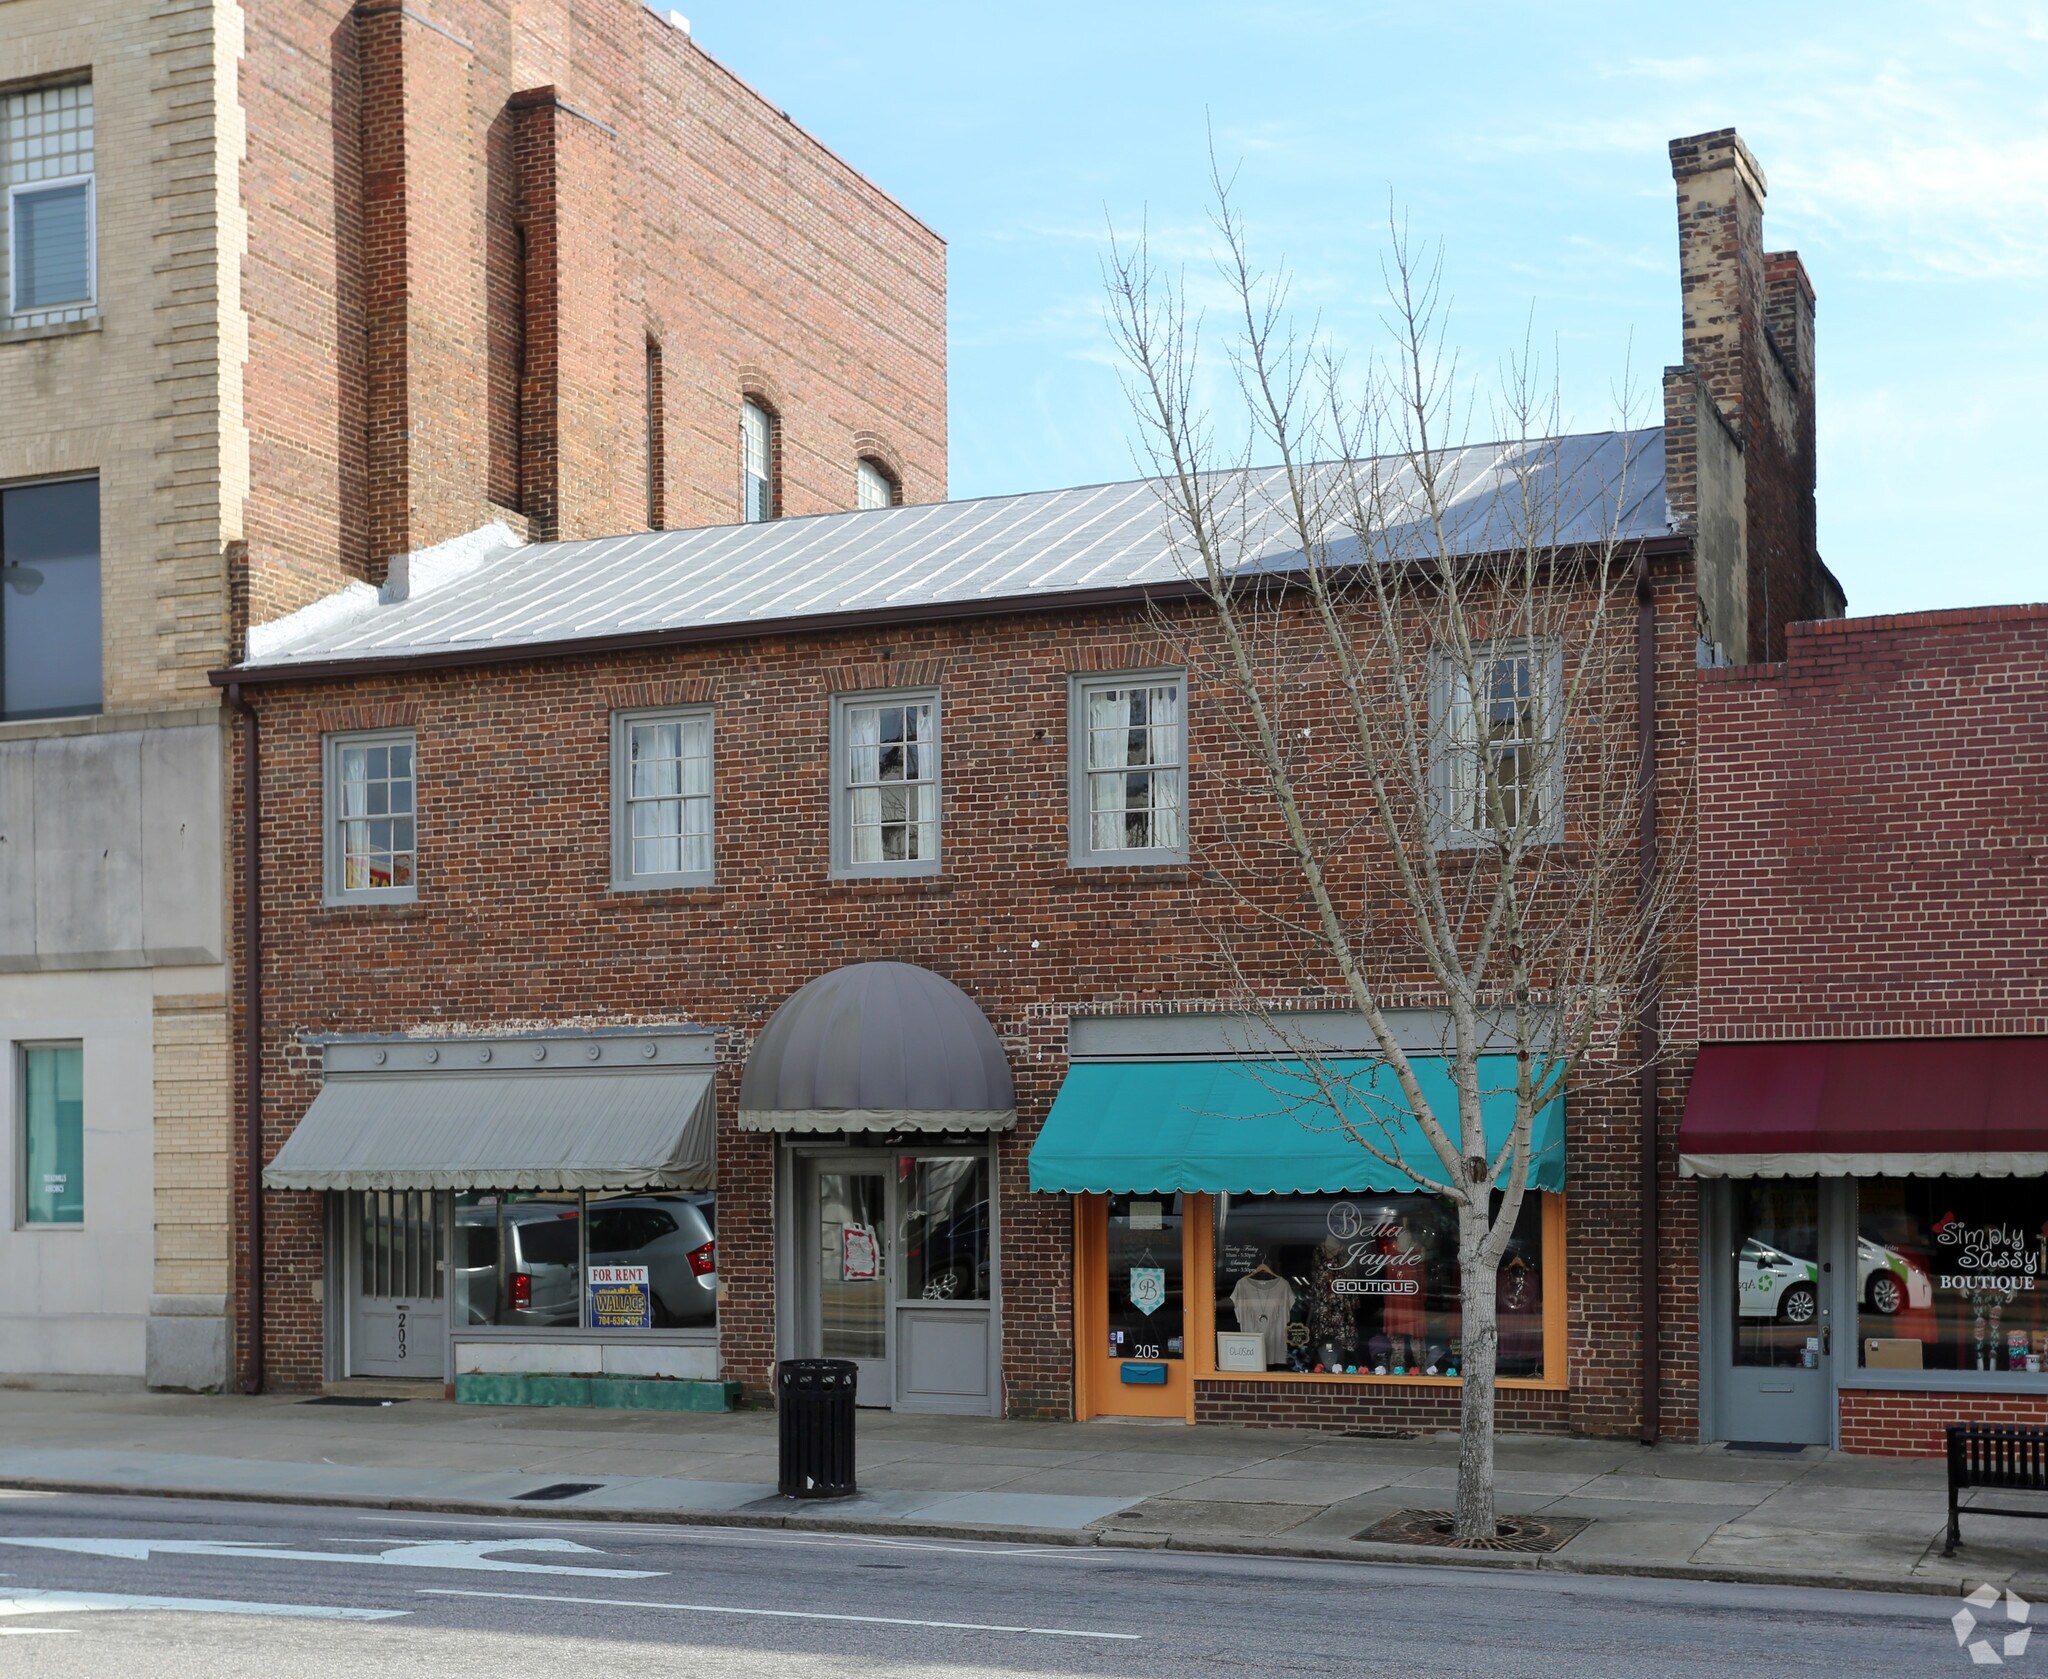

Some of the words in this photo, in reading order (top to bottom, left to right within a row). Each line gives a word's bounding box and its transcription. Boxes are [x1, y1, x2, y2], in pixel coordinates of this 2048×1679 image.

[1327, 1201, 1404, 1239] Bella
[1937, 1222, 2024, 1251] Simply
[1327, 1240, 1422, 1276] Jayde
[1958, 1245, 2039, 1274] Sassy
[592, 1269, 612, 1281] FOR
[615, 1268, 644, 1281] RENT
[1940, 1275, 2035, 1293] BOUTIQUE
[1138, 1278, 1158, 1301] B
[1336, 1281, 1414, 1292] BOUTIQUE
[595, 1295, 644, 1311] WALLACE
[398, 1312, 407, 1359] 203
[1134, 1344, 1159, 1359] 205
